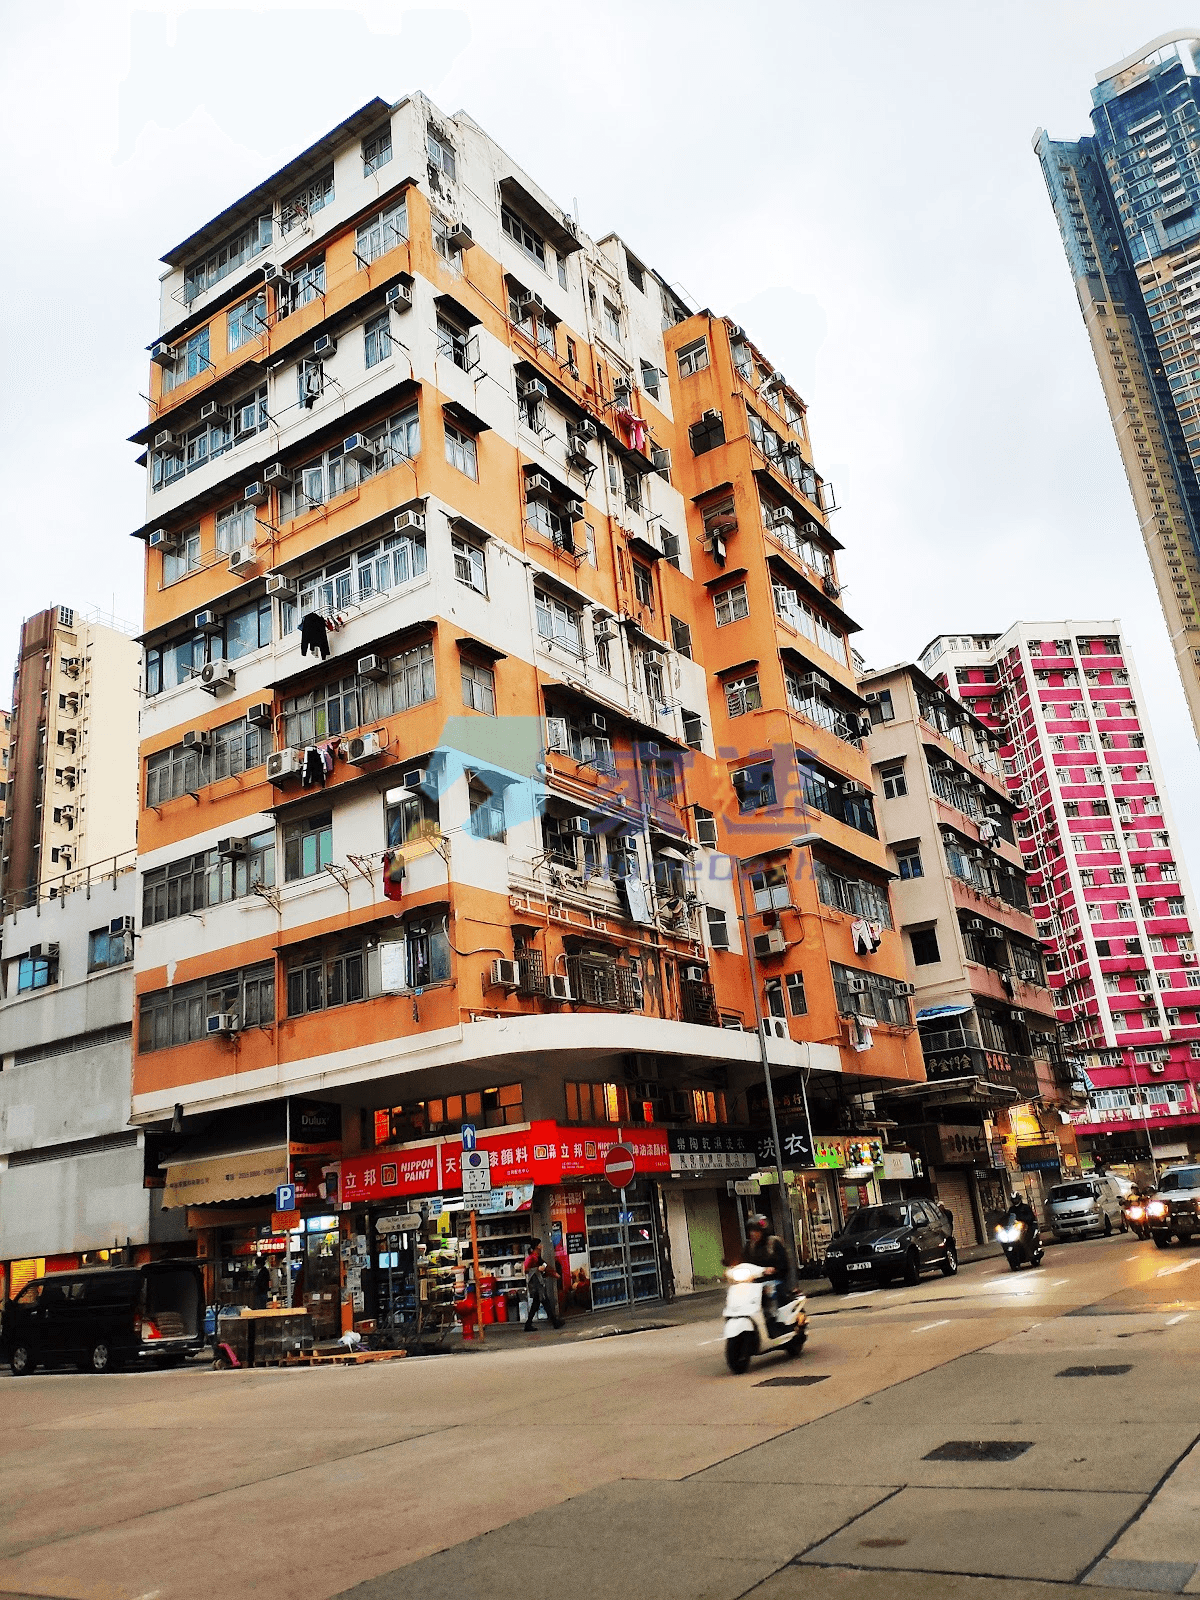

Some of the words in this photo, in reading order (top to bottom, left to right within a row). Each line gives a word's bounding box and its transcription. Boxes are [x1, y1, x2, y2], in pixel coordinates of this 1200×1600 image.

[301, 1115, 327, 1125] Dulux
[561, 1142, 583, 1159] 立邦
[757, 1132, 809, 1159] 洗衣
[400, 1158, 434, 1173] NIPPON
[445, 1146, 528, 1174] 天漆顏料
[345, 1168, 377, 1190] 立邦
[404, 1169, 431, 1183] PAINT
